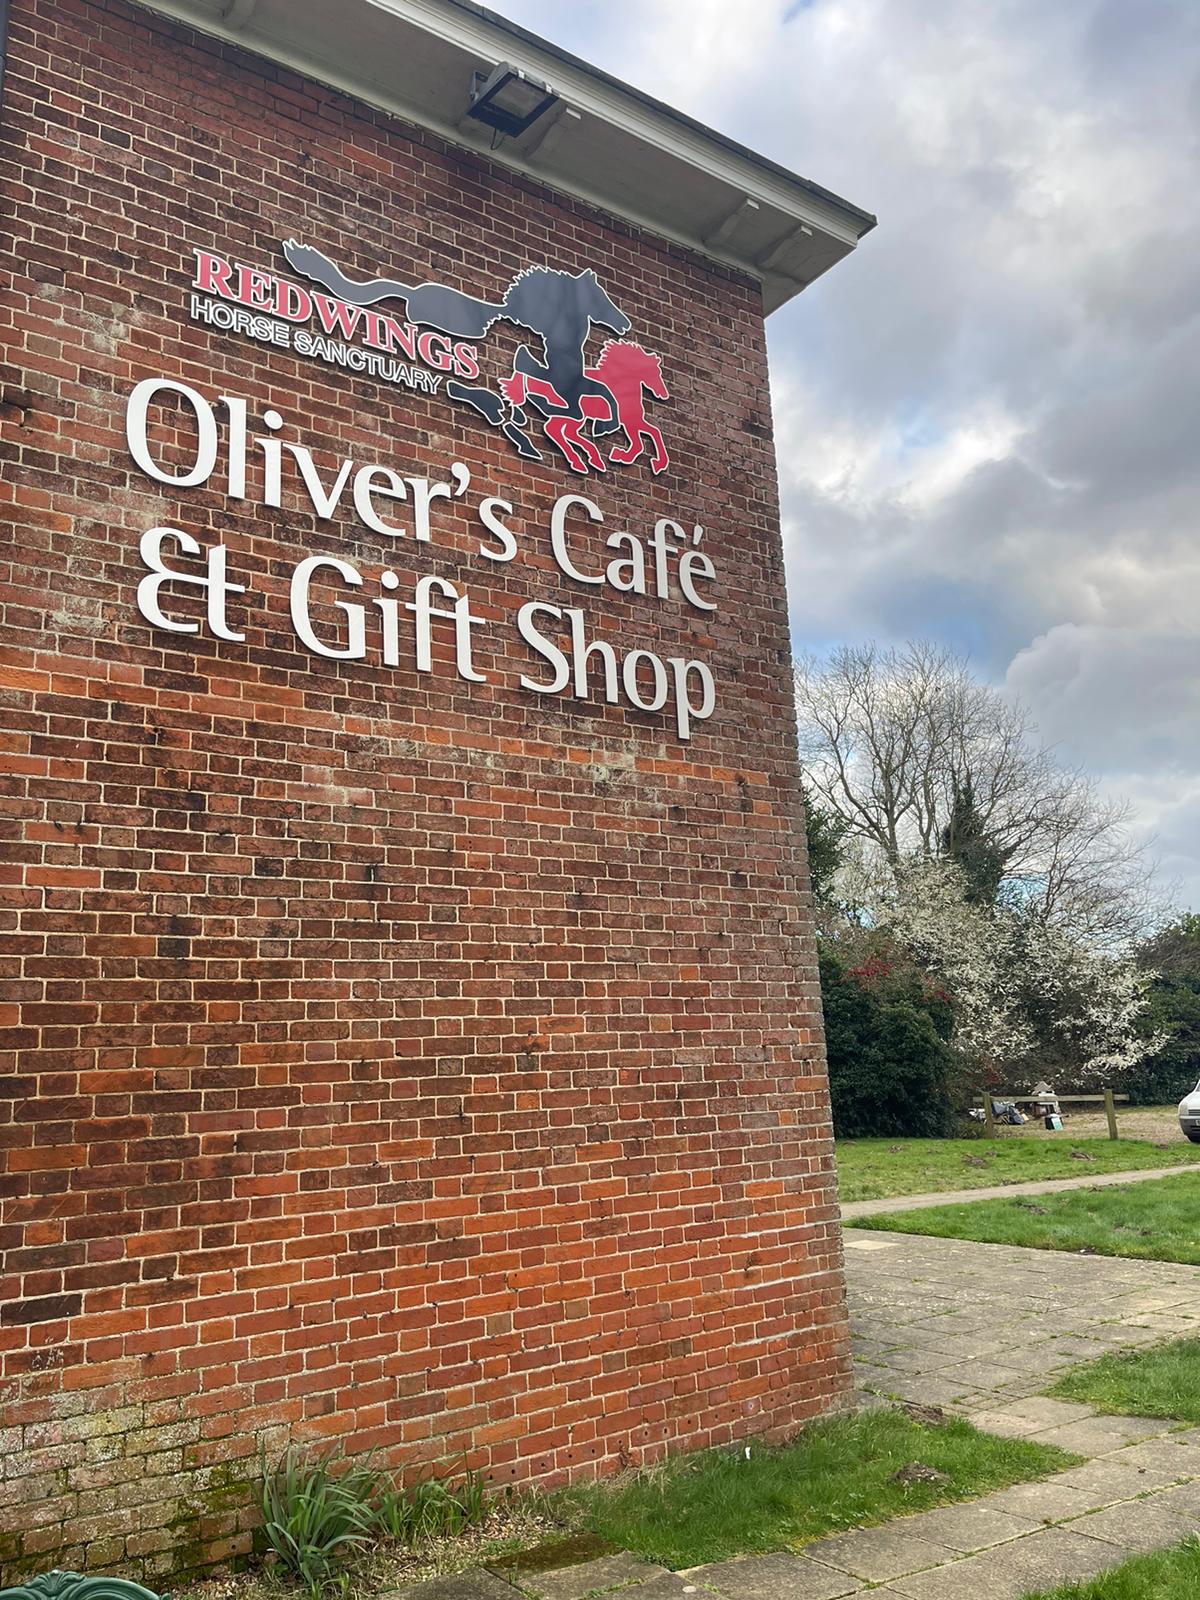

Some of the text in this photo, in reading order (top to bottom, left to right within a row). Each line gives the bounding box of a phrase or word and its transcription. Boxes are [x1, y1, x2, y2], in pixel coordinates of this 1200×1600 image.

[189, 294, 443, 395] HORSE SANCTUARY
[192, 247, 480, 380] REDWINGS
[126, 377, 718, 611] Oliver's Café
[290, 555, 486, 683] Gift
[517, 601, 716, 740] Shop
